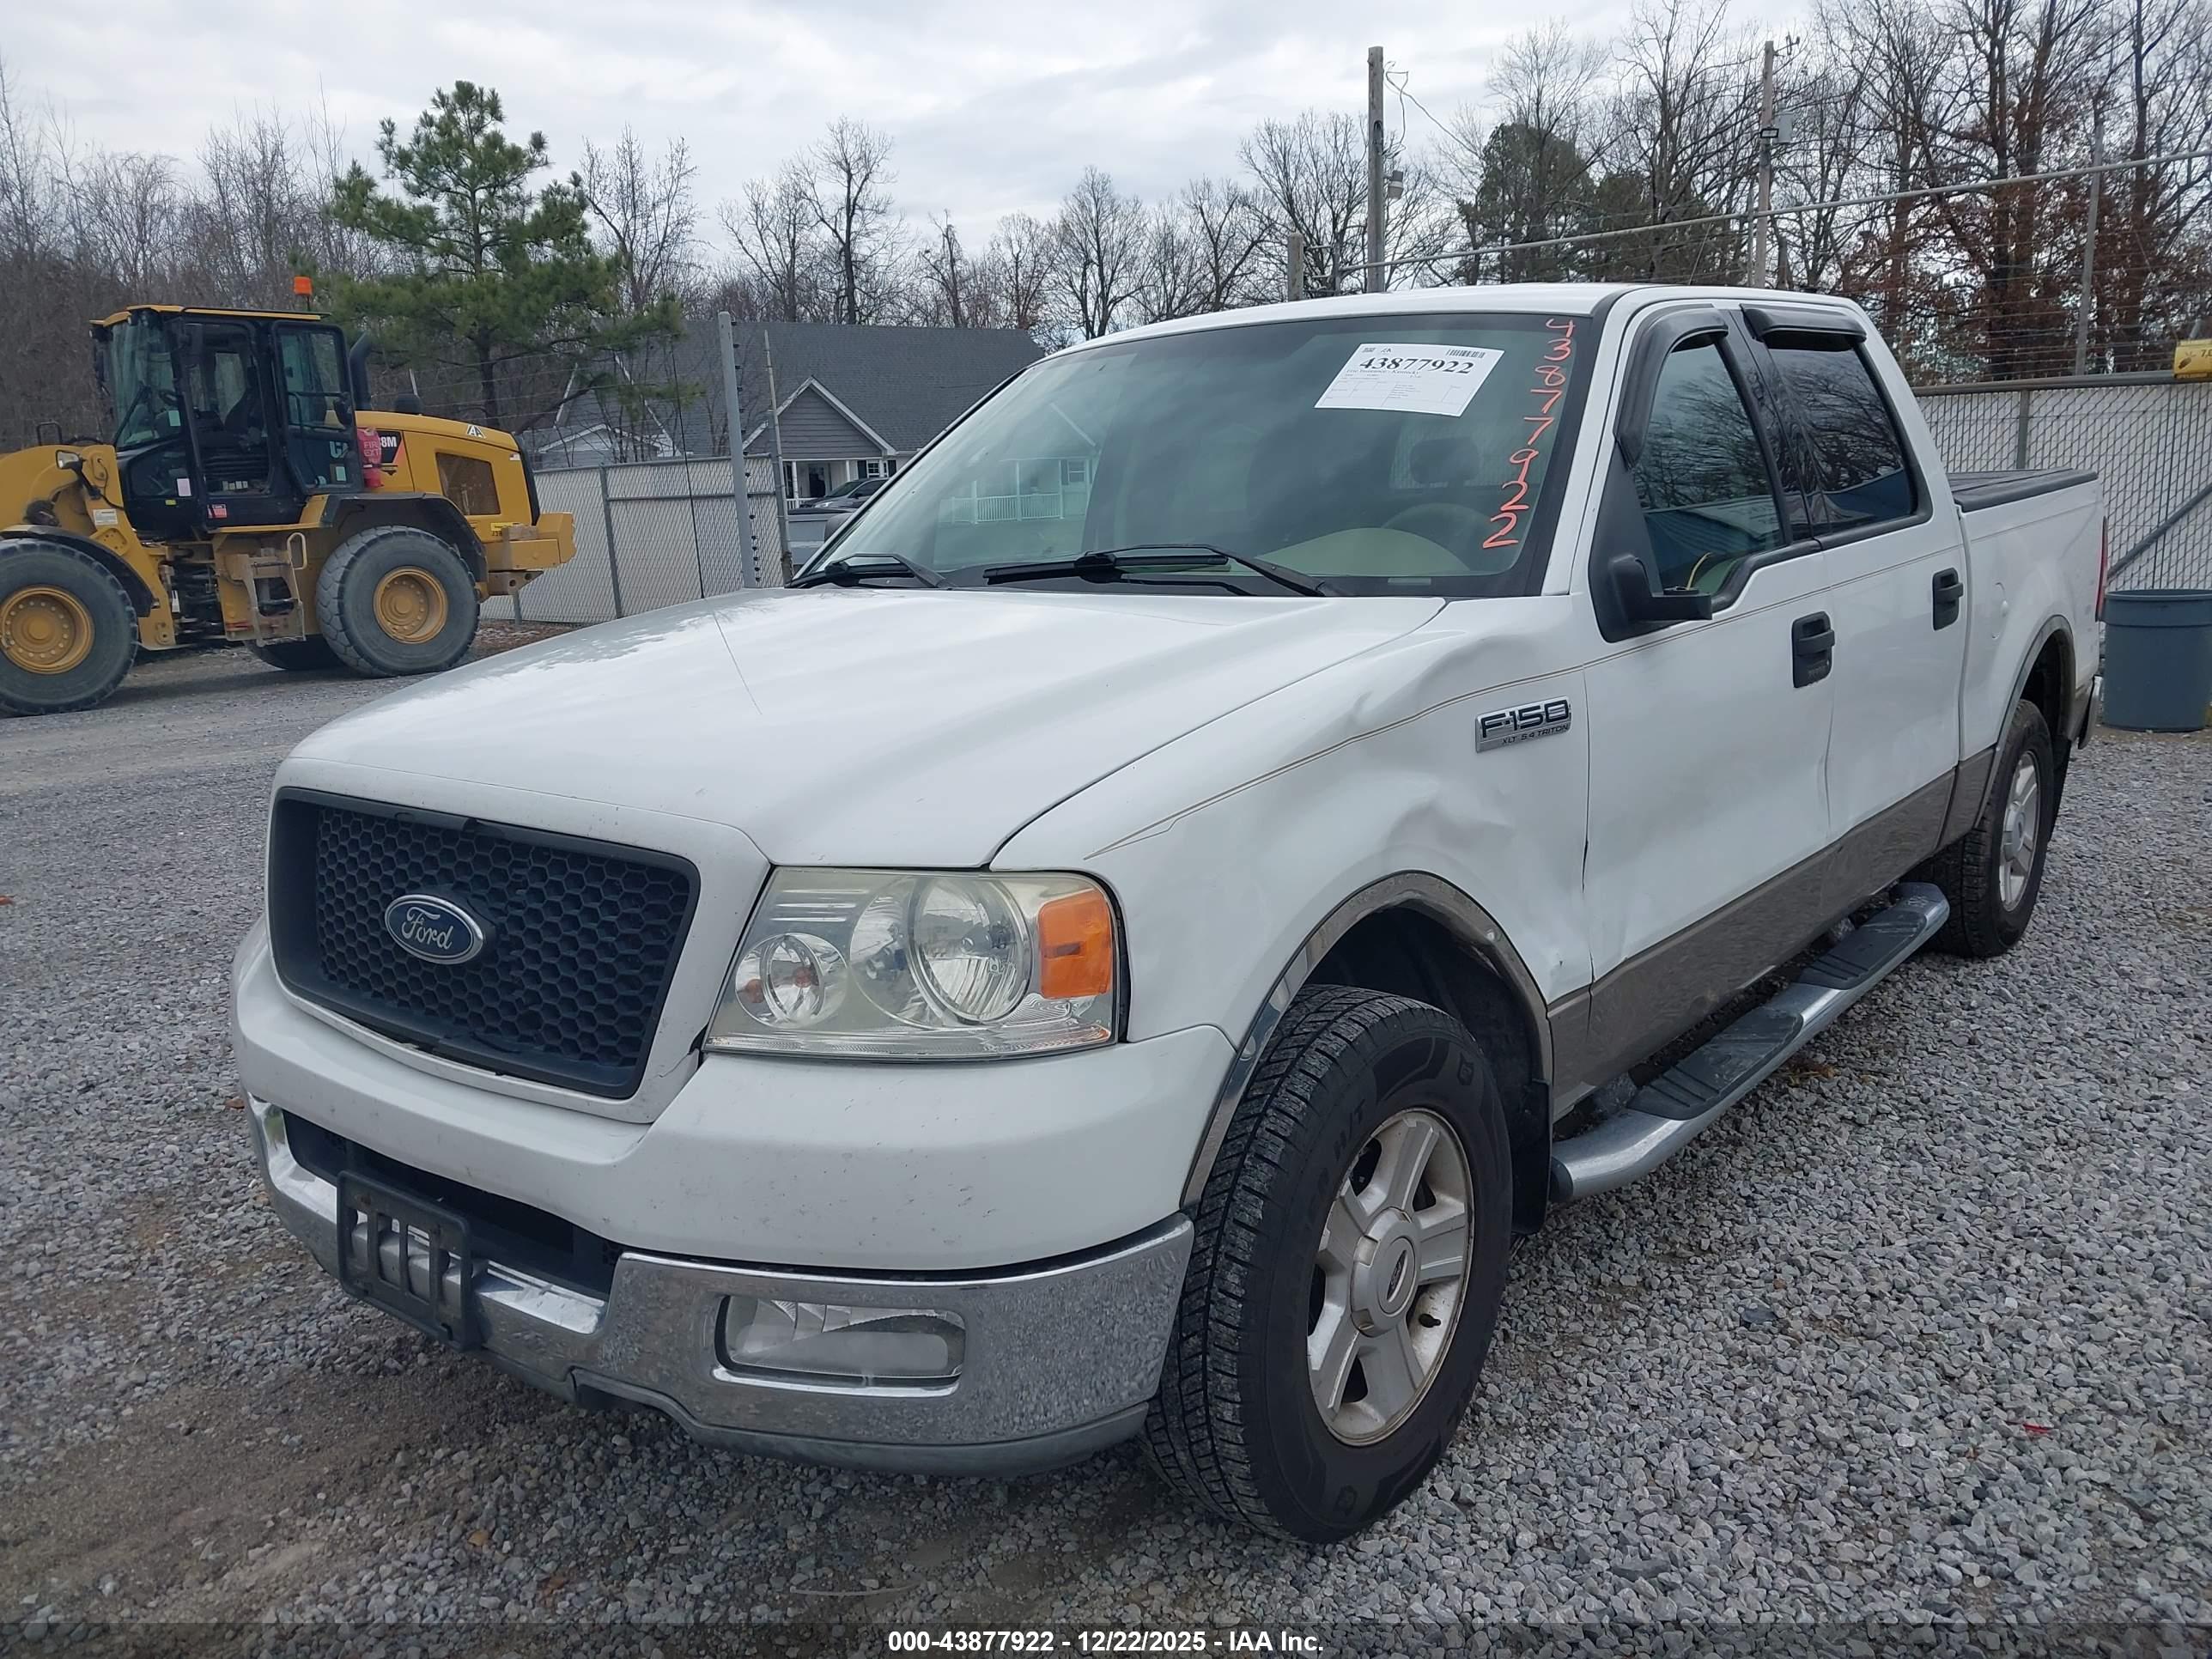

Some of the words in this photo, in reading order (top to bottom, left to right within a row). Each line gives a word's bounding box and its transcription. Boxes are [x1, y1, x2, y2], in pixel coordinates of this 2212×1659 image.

[1359, 357, 1474, 374] 43877922
[380, 436, 398, 447] 8M
[1482, 318, 1576, 549] 43877922
[1480, 699, 1569, 738] F-150
[1537, 725, 1569, 736] TRITON
[401, 906, 453, 950] Ford
